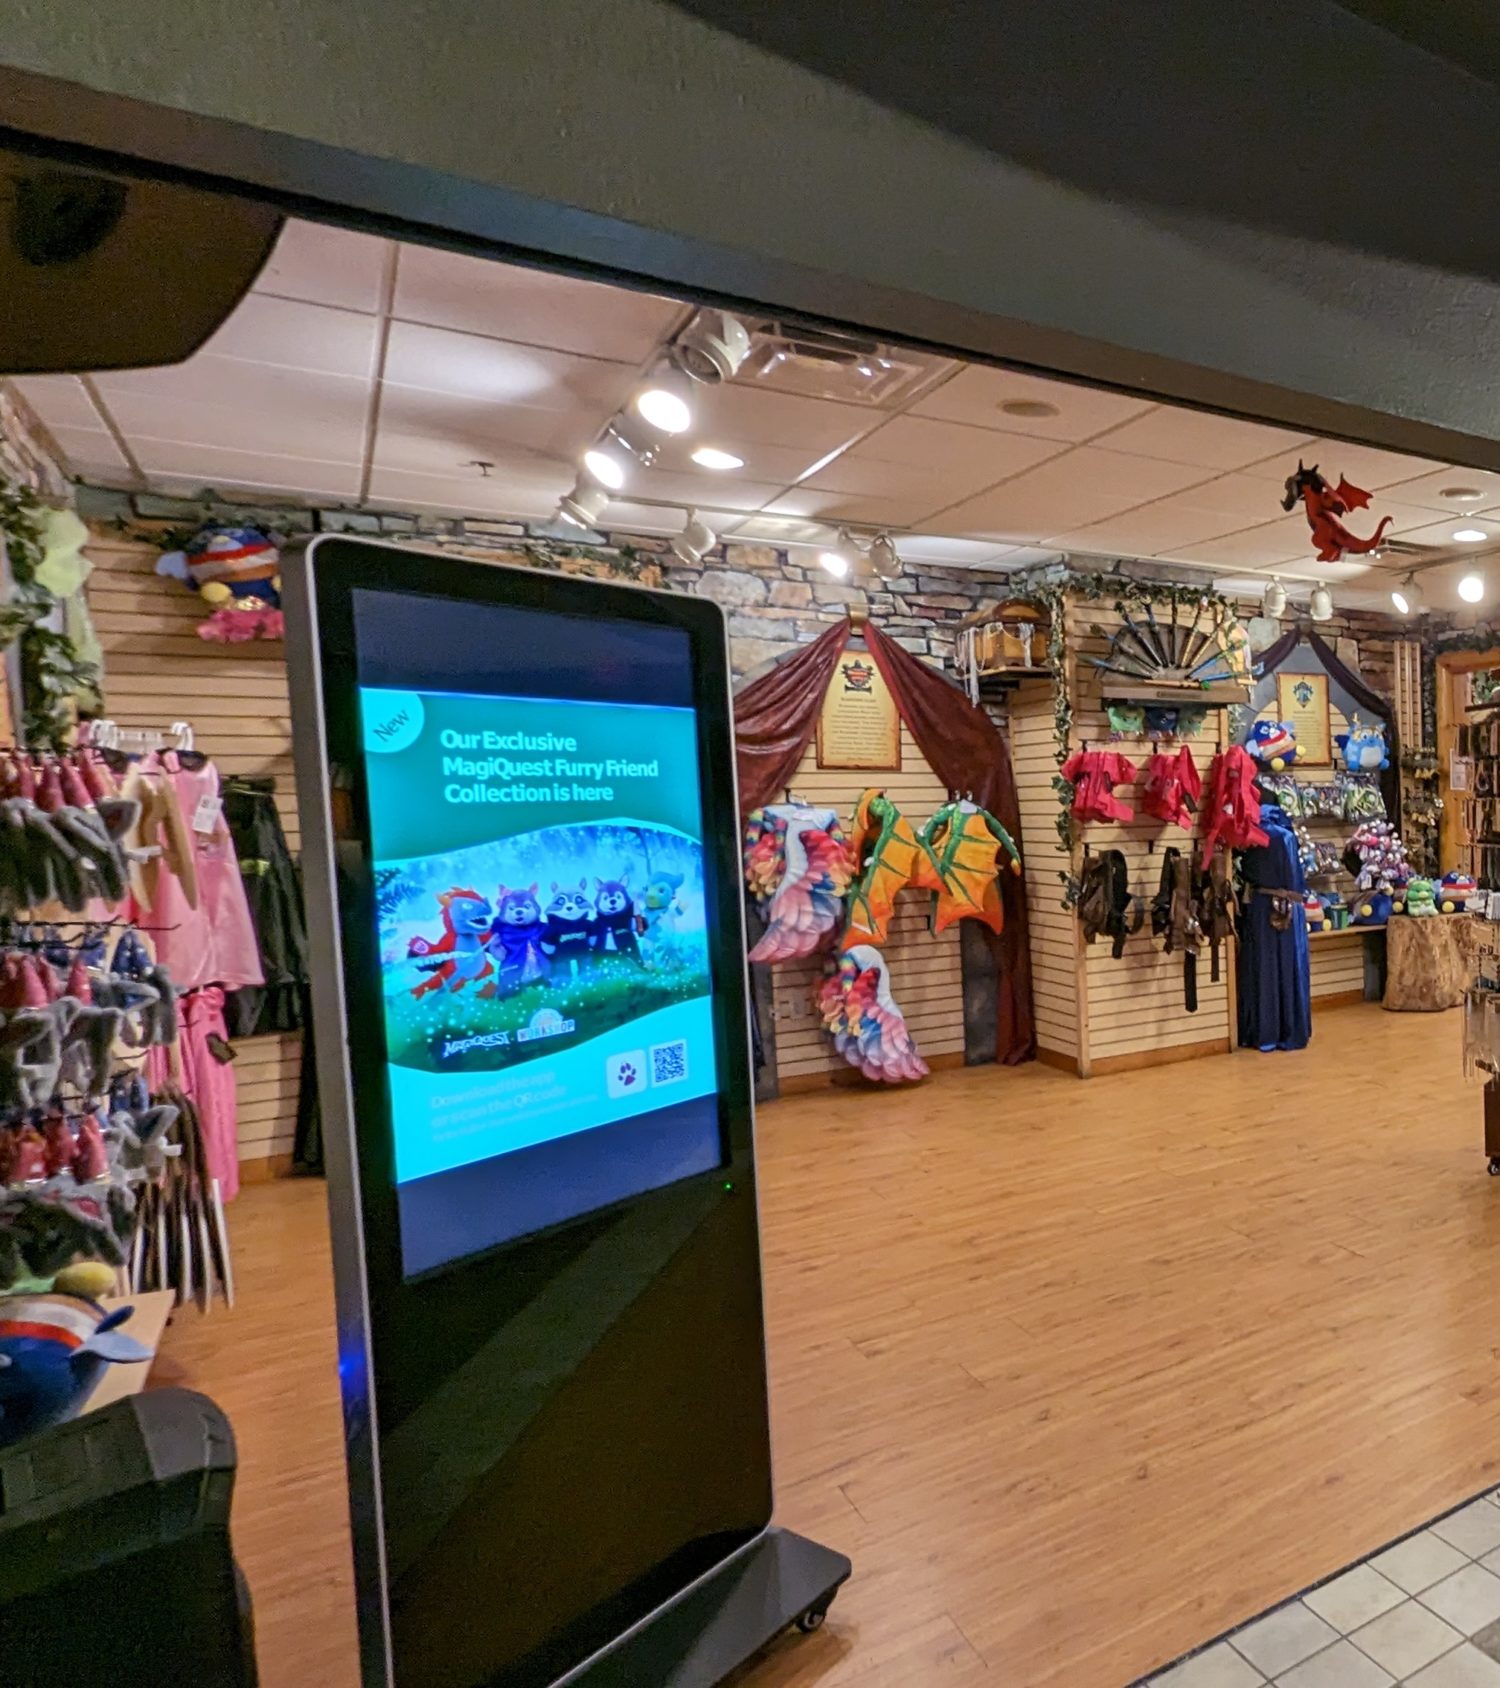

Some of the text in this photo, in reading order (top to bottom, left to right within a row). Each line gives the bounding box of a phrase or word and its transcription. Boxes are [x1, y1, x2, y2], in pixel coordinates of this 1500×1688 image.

[373, 709, 410, 741] New
[440, 729, 577, 751] Our Exclusive
[443, 758, 658, 780] MagiQuest Furry Friend
[445, 784, 613, 803] Collection is here
